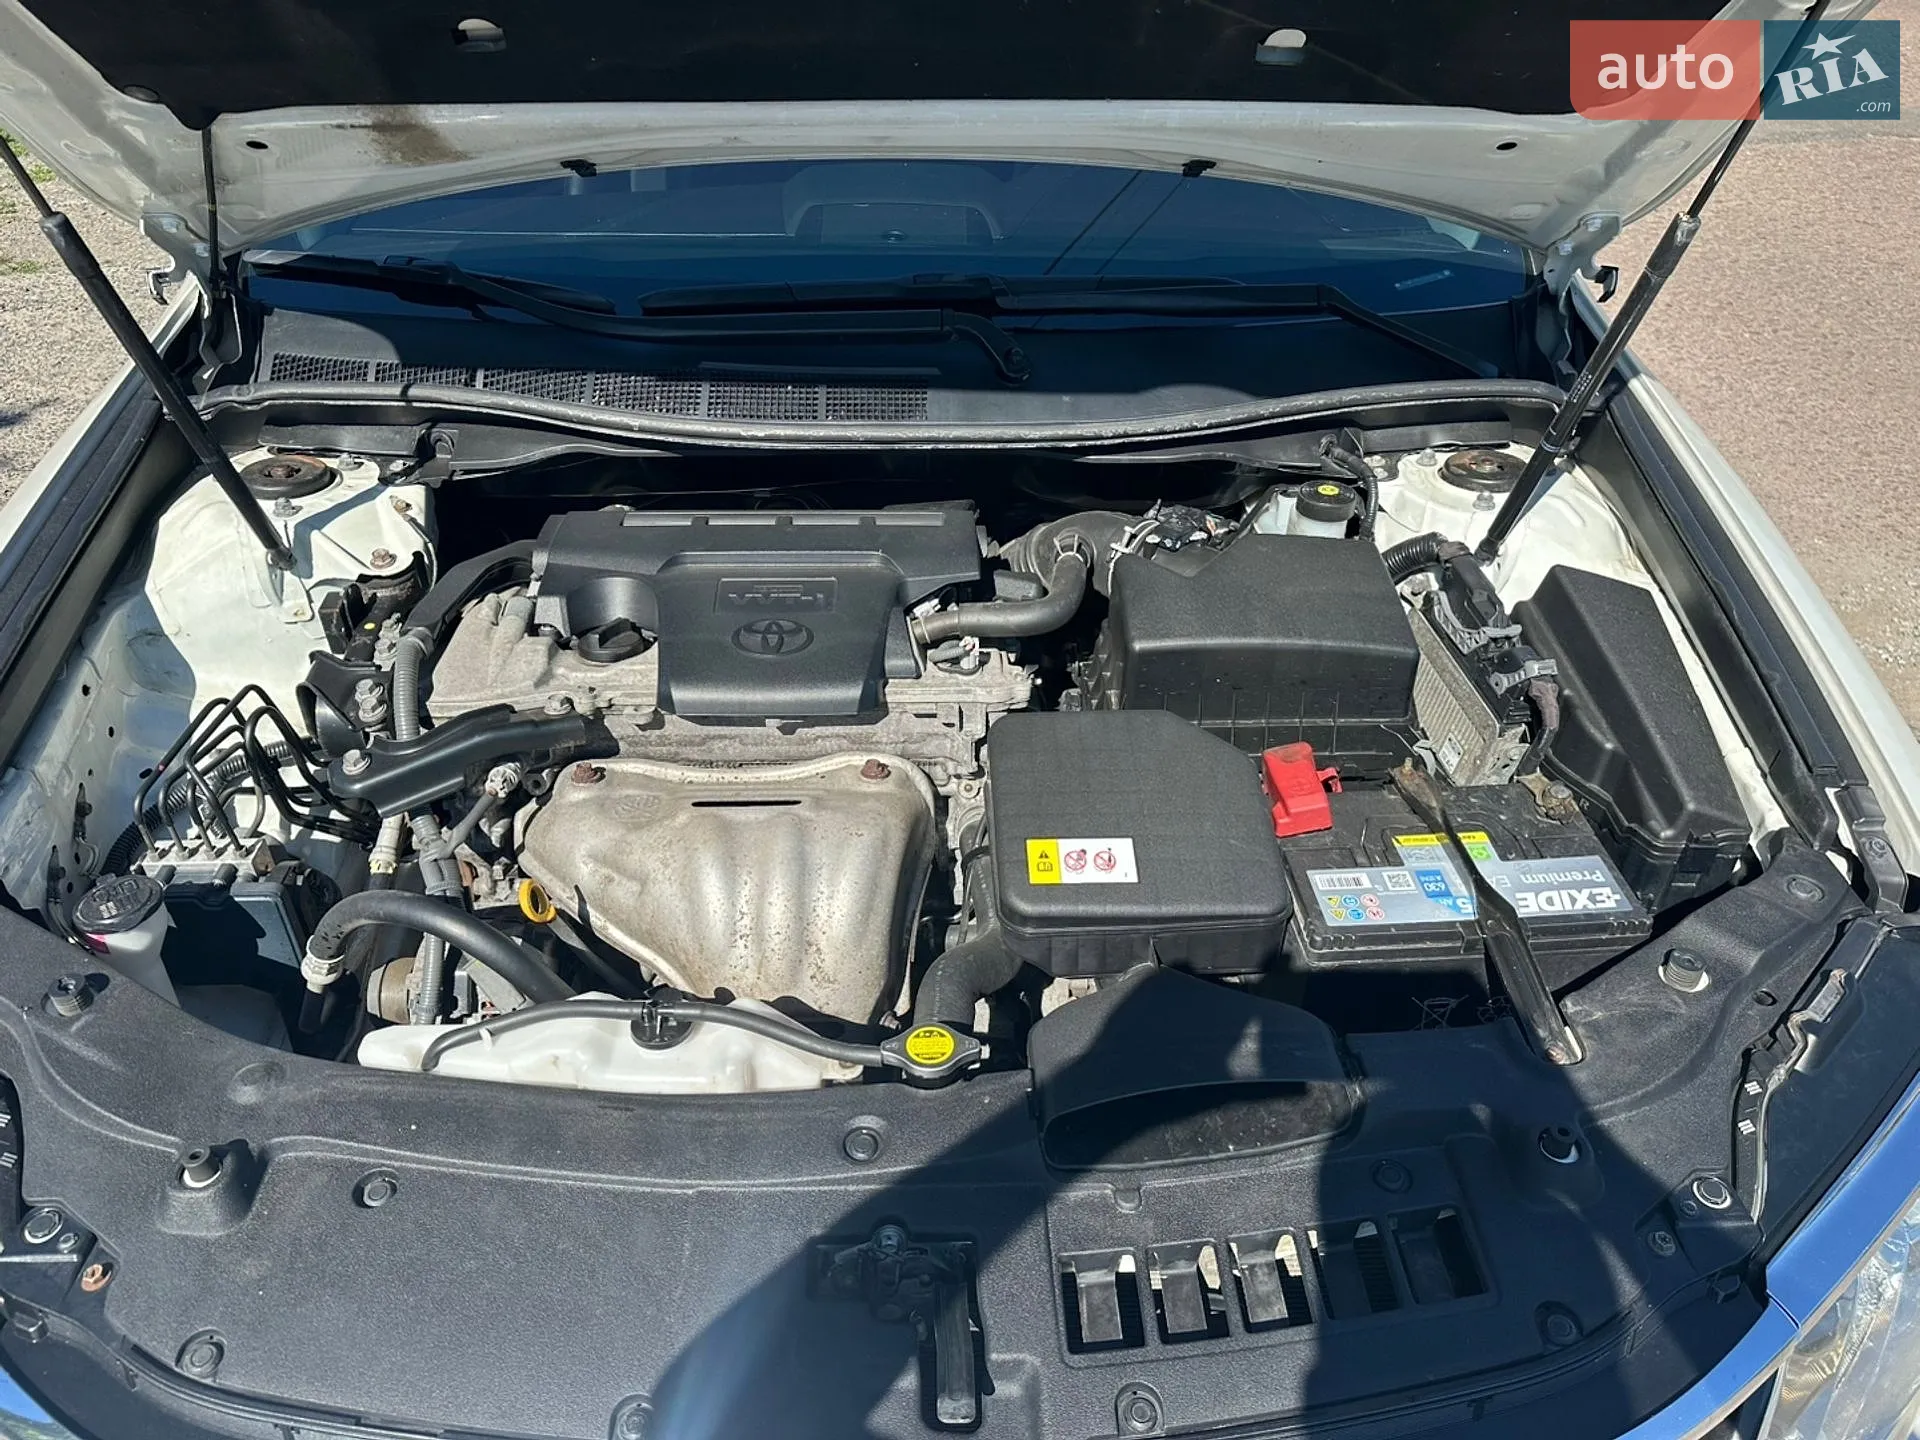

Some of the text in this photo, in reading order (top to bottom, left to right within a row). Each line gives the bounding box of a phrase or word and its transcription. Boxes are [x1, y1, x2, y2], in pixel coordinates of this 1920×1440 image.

[1520, 868, 1606, 886] Premium
[1423, 881, 1445, 892] 630
[1515, 886, 1621, 914] EXIDE
